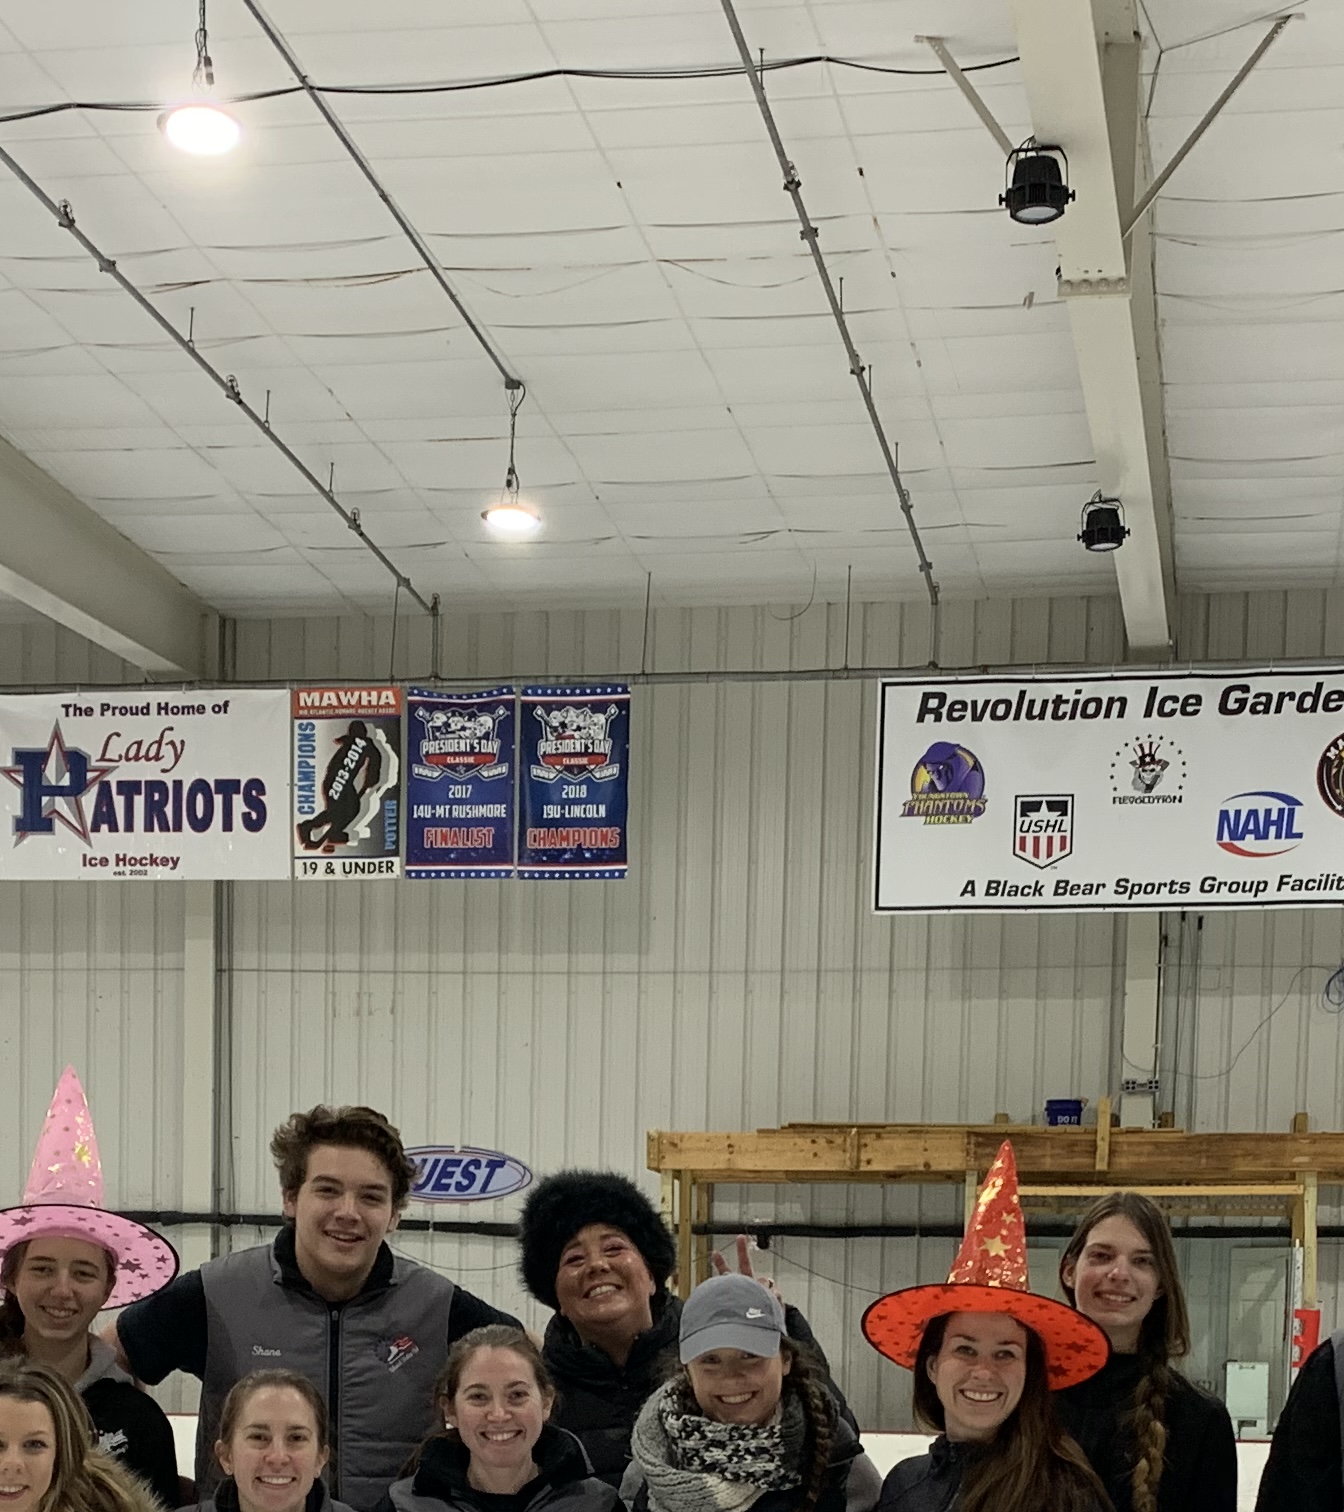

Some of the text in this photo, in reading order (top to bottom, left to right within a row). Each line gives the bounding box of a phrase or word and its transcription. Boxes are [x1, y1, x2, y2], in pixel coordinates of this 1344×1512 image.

[298, 691, 396, 707] MAWHA
[915, 688, 1129, 724] Revolution
[1143, 686, 1203, 719] Ice
[61, 700, 231, 717] The Proud Home of
[95, 726, 186, 773] Lady
[422, 739, 499, 755] PRESIDENT'S DAY
[539, 739, 611, 755] PRESIDENT'S DAY
[297, 721, 316, 815] CHAMPIONS
[446, 756, 475, 764] CLASSIC
[562, 757, 589, 765] CLASSIC
[328, 737, 368, 801] 2013-2014
[448, 785, 473, 798] 2017
[561, 784, 588, 798] 2018
[412, 803, 507, 819] 14U-MT RUSHMORE
[542, 804, 606, 819] 19U-LINCOLN
[901, 799, 989, 817] PHANTOMS
[384, 799, 398, 850] POTTER
[924, 814, 974, 825] HOCKEY
[1019, 819, 1068, 833] USHL
[1216, 807, 1304, 842] NAHL
[424, 827, 495, 849] FINALIST
[527, 826, 620, 849] CHAMPIONS
[82, 853, 181, 870] Ice Hockey
[302, 860, 395, 875] 19 & UNDER
[960, 879, 976, 897] A
[984, 879, 1045, 897] Black
[1052, 879, 1106, 896] Bear
[1113, 877, 1191, 900] Sports
[1198, 875, 1269, 898] Group
[407, 1158, 506, 1194] UEST
